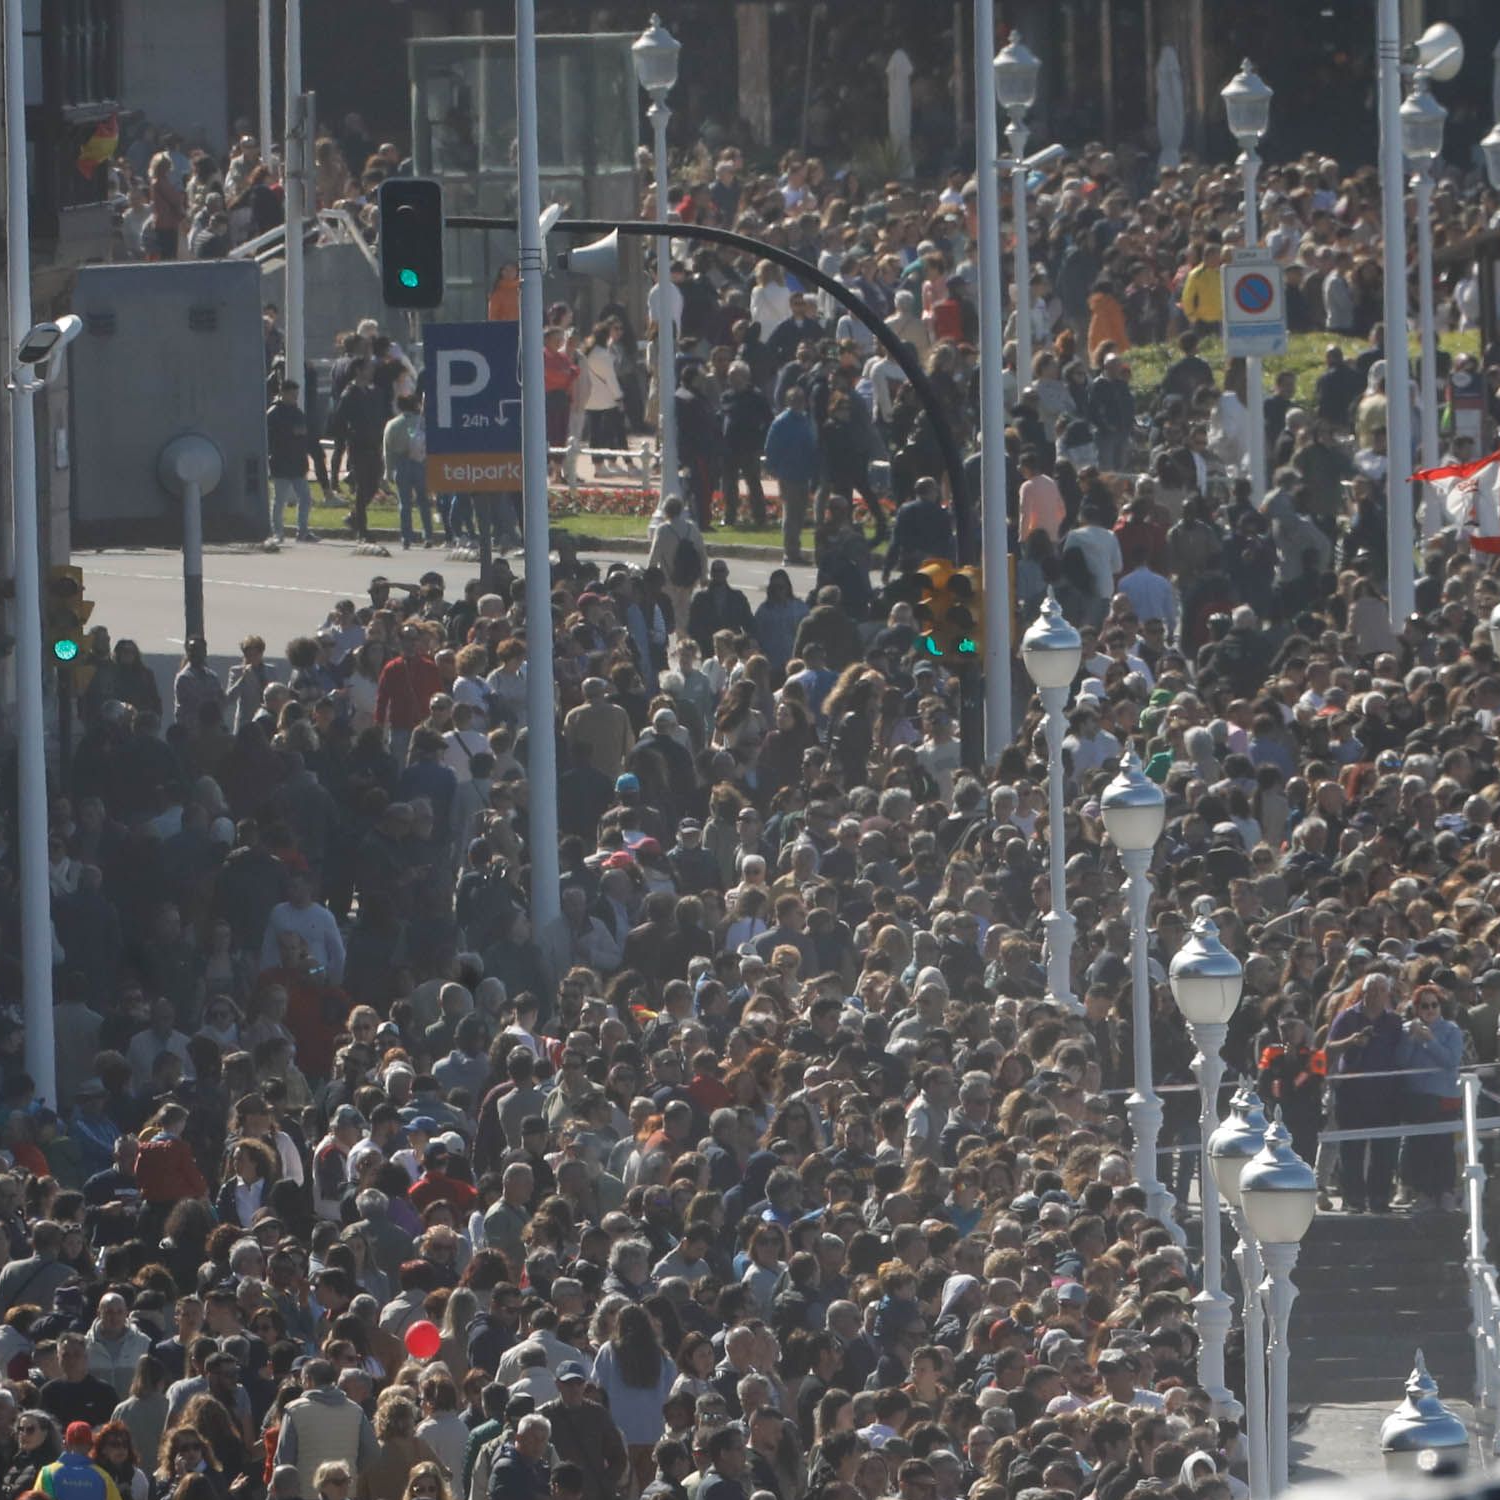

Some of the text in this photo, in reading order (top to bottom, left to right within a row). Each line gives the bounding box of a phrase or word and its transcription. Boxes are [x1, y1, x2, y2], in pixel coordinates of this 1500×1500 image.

[436, 349, 491, 428] P
[462, 414, 489, 427] 24h
[444, 463, 522, 482] telpark
